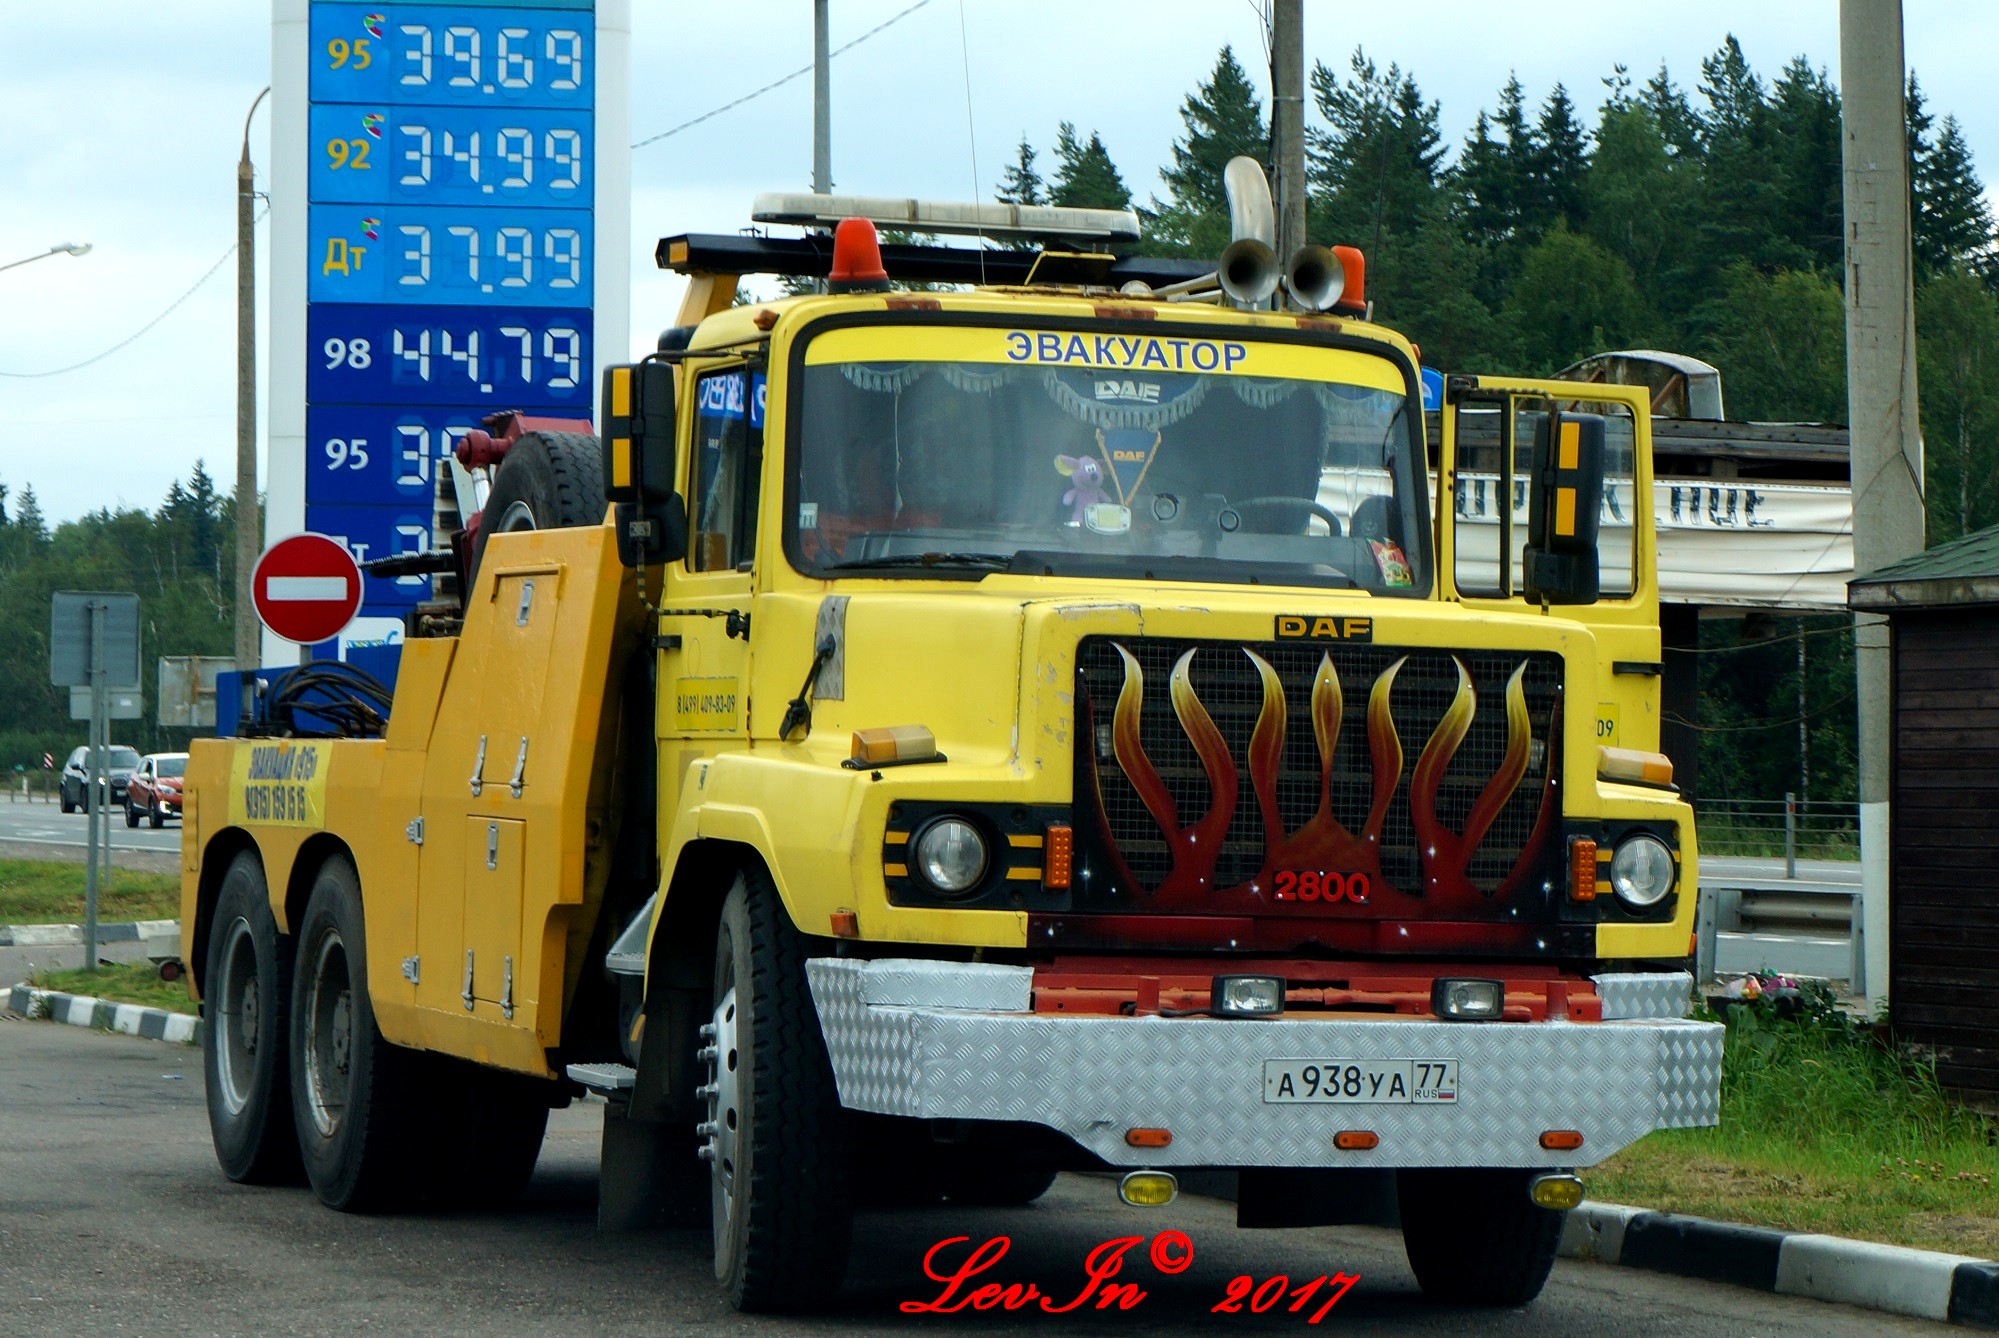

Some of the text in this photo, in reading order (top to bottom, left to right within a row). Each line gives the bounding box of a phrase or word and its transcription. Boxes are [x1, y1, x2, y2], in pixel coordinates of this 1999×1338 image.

[327, 24, 582, 94] 95 39.69
[327, 125, 581, 194] 92 34.99
[323, 225, 581, 294] Дт 37.99
[323, 326, 581, 394] 98 44.79
[1005, 331, 1247, 372] ЭВАКУАТОР
[1094, 380, 1161, 404] DAF
[324, 438, 369, 471] 95
[1113, 450, 1145, 462] DAF
[1278, 616, 1371, 638] DAF
[1274, 870, 1370, 904] 2800
[1416, 1063, 1447, 1089] 77
[1414, 1089, 1438, 1099] RUS
